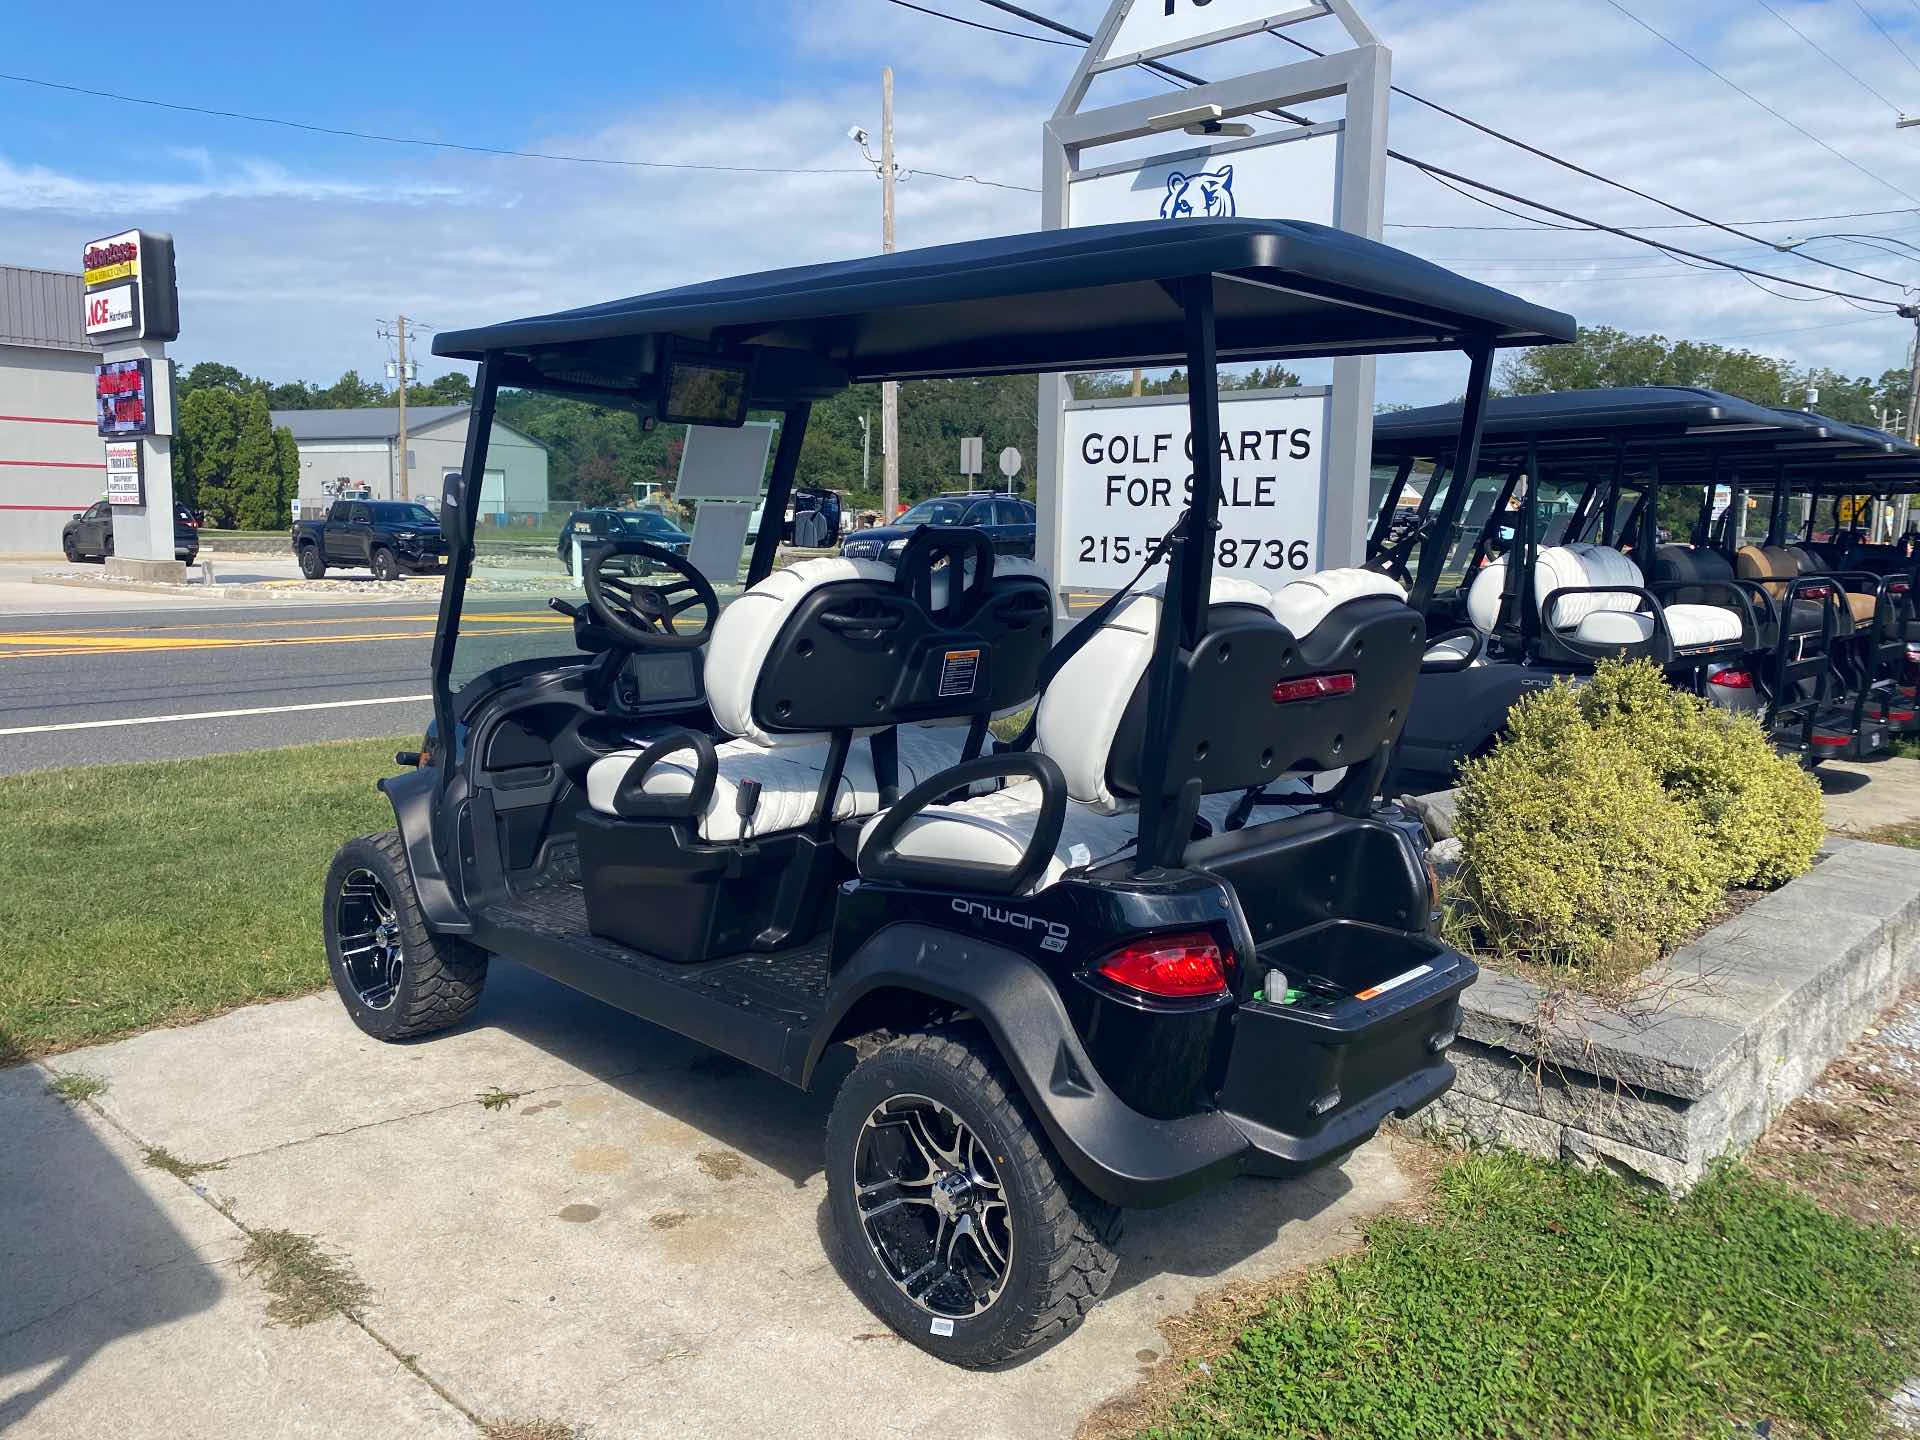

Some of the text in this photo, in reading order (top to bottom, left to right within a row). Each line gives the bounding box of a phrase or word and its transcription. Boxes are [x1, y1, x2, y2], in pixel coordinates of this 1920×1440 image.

[86, 296, 109, 327] ACE
[109, 310, 132, 322] Hardware
[1082, 432, 1172, 464] GOLF
[1106, 474, 1171, 507] FOR
